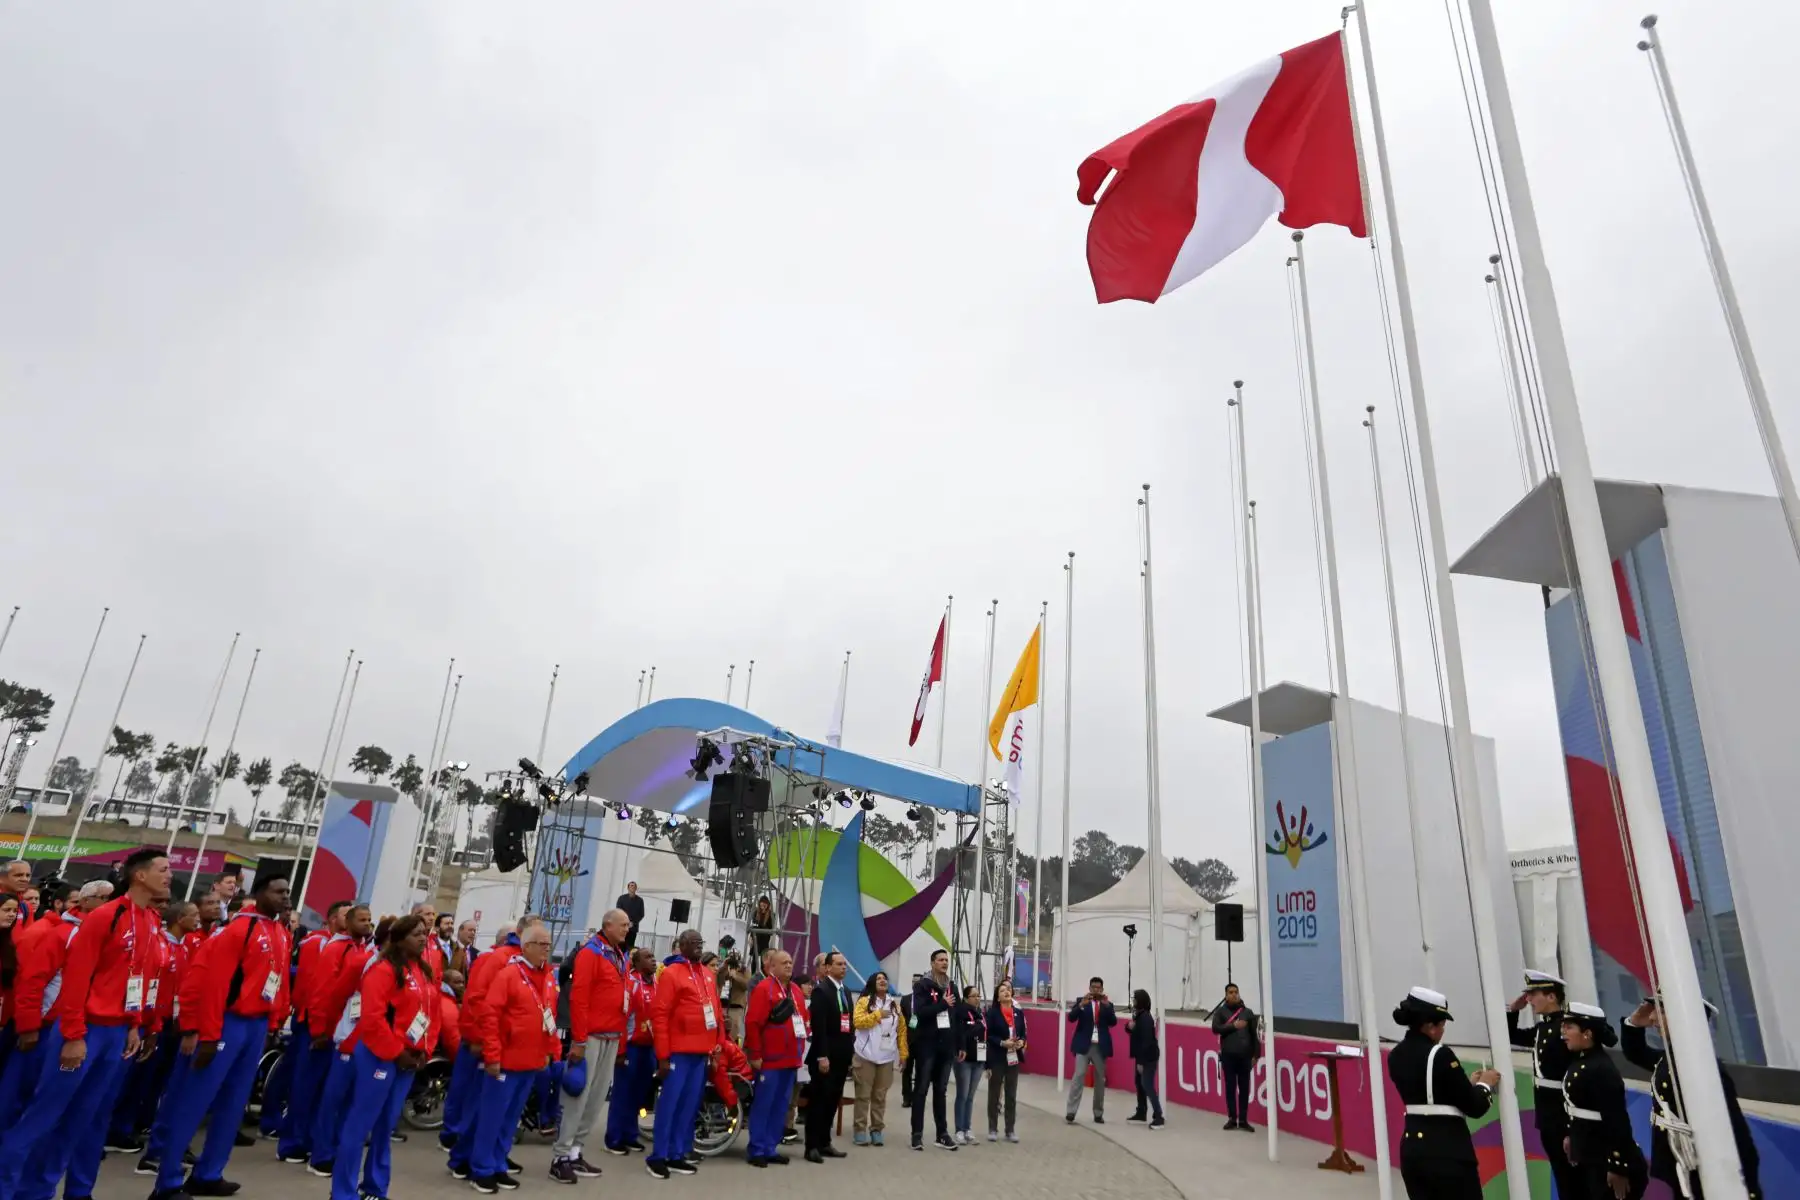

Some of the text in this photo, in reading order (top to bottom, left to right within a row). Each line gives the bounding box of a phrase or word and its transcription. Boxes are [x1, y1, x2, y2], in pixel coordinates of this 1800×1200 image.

[60, 845, 89, 856] RLAX
[1547, 855, 1555, 865] &
[1277, 914, 1317, 940] 2019
